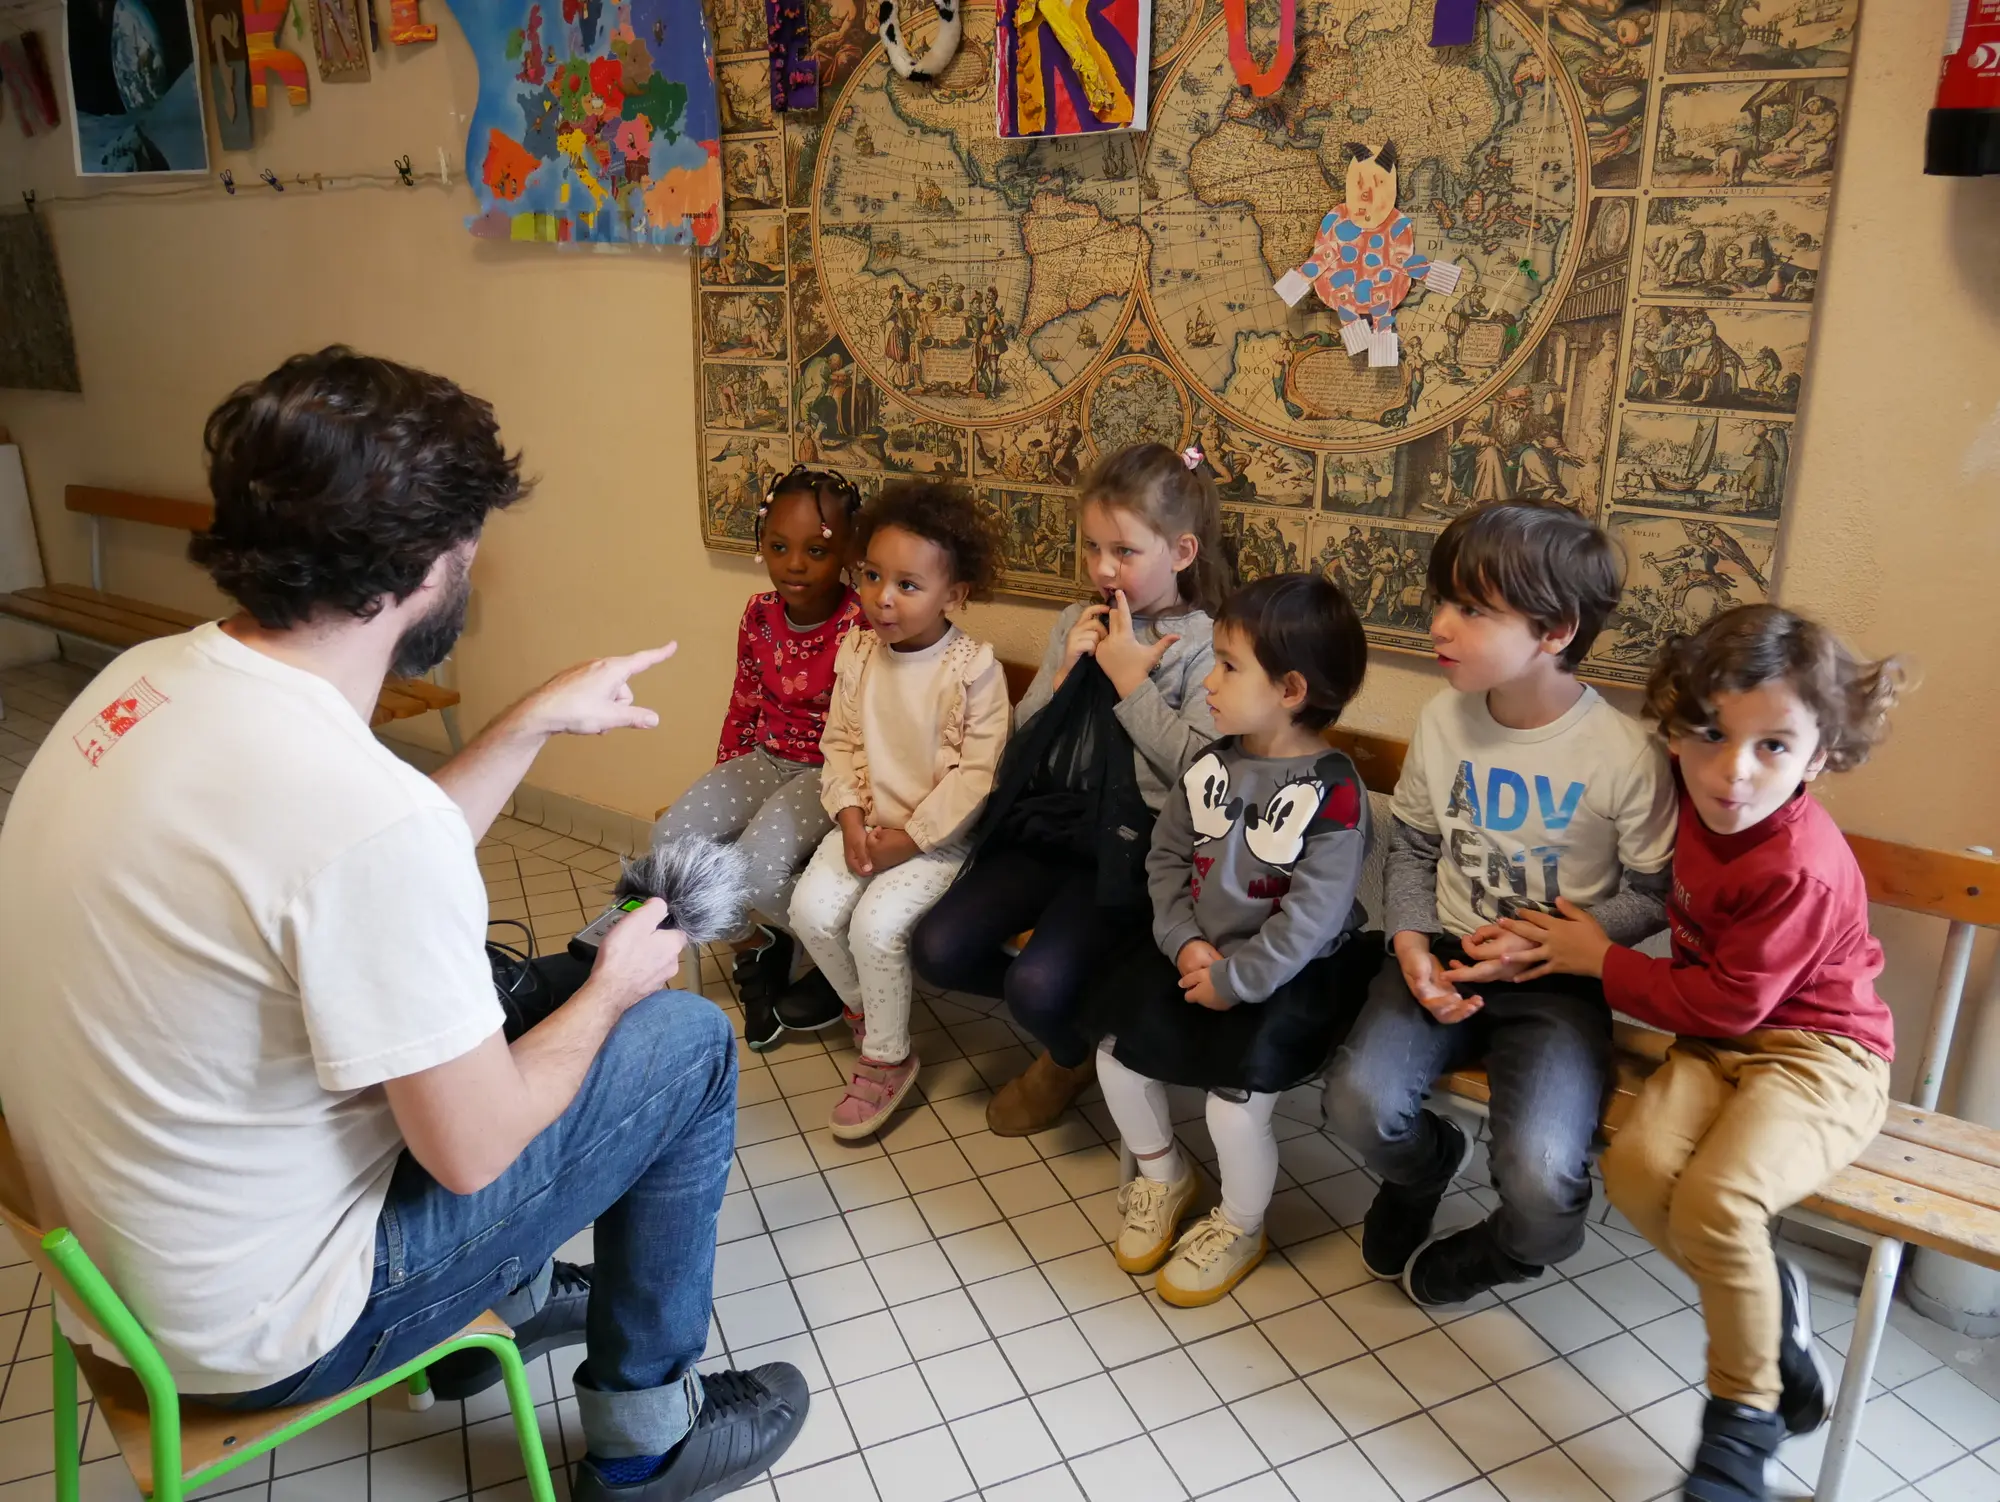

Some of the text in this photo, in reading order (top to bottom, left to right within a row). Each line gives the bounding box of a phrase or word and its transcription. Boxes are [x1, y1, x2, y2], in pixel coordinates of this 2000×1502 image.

[922, 161, 955, 171] MAR
[1096, 186, 1136, 197] NORT
[1707, 188, 1766, 196] AUGUSTUS
[957, 196, 988, 207] DEL
[1445, 759, 1586, 834] ADV
[1451, 828, 1572, 903] ENT
